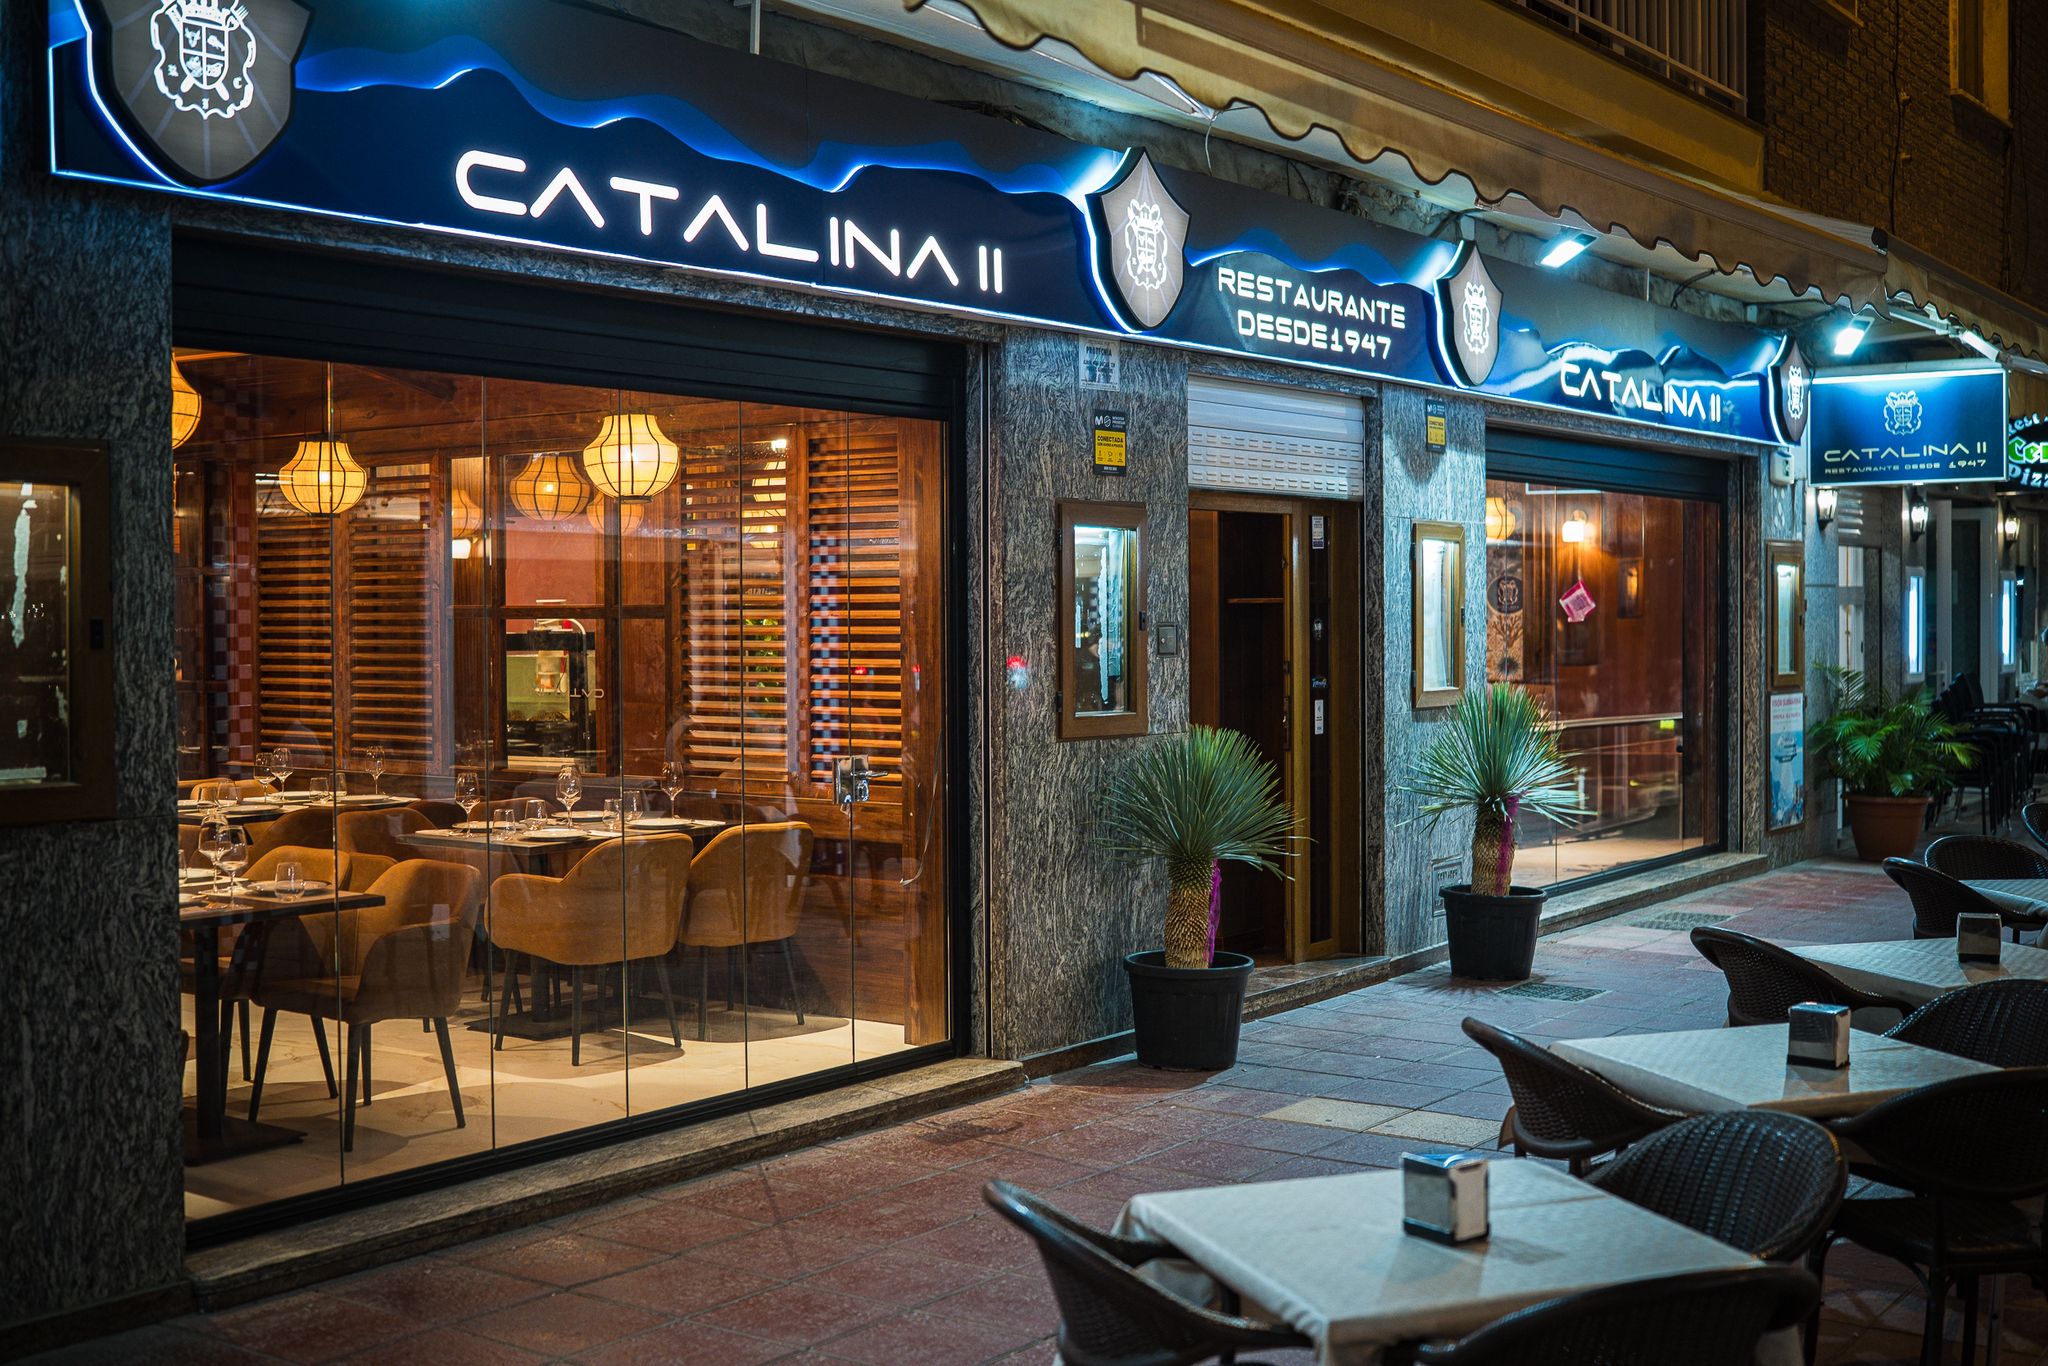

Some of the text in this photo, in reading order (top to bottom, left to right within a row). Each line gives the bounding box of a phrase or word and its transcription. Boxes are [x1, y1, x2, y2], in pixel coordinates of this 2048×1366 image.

[455, 150, 1003, 294] CATALINA II
[1218, 266, 1406, 330] RESTAURANTE
[1560, 362, 1721, 423] CATALINA II
[1823, 441, 1987, 463] CATALINA II
[1824, 459, 1987, 475] RESTAURANTE DESDE 1947
